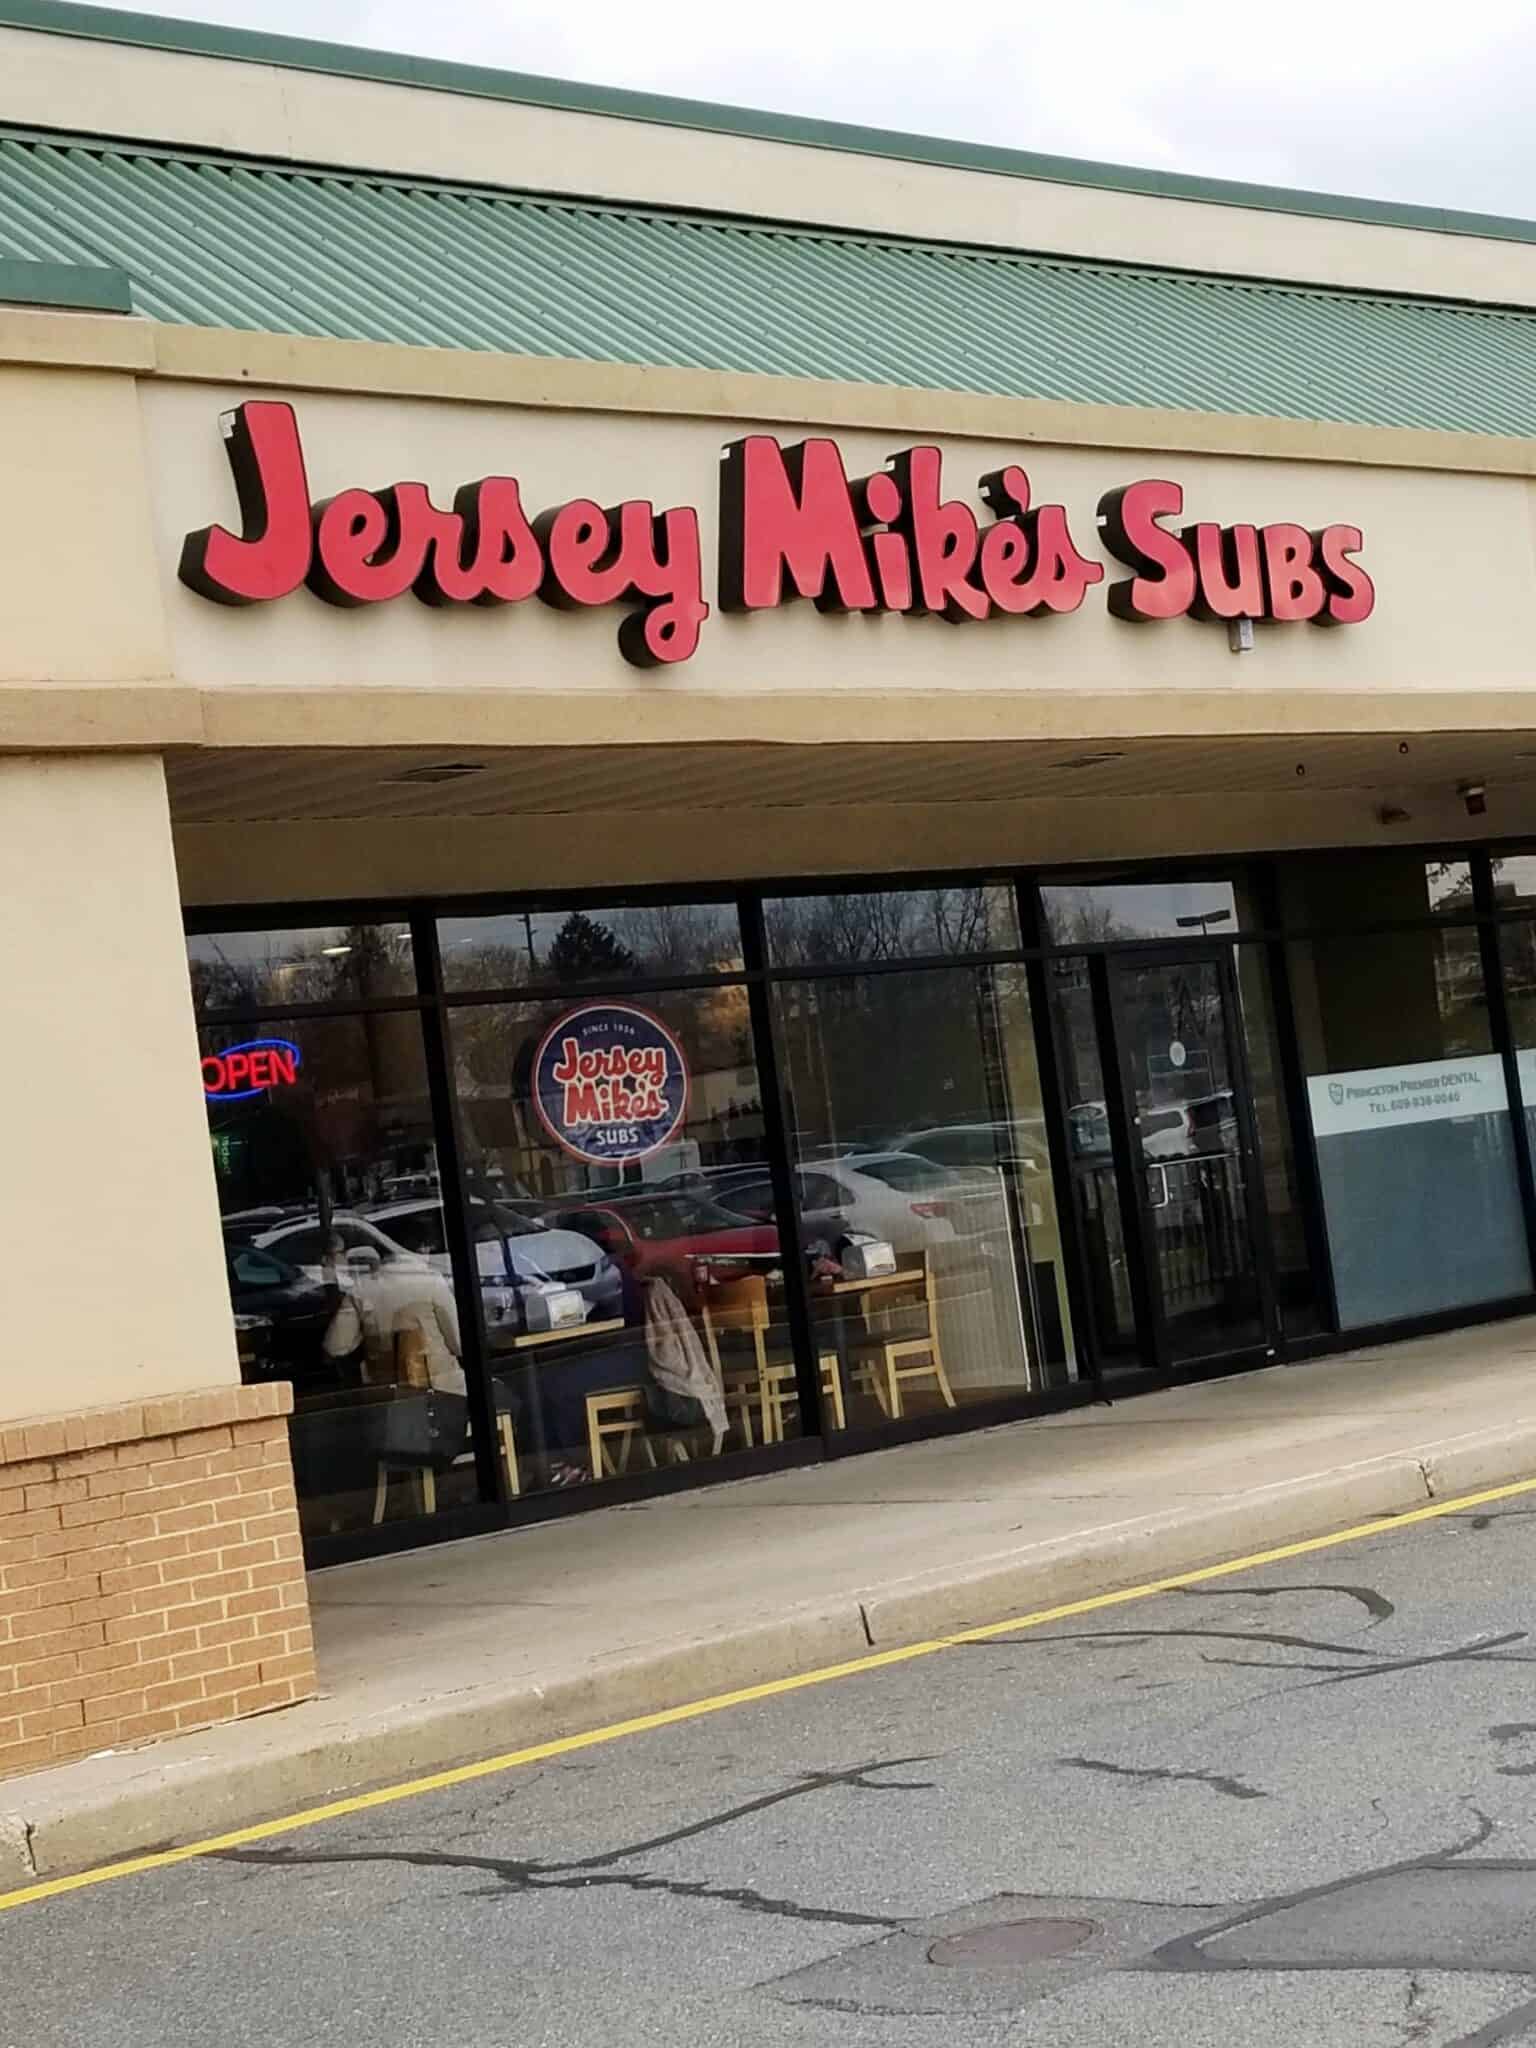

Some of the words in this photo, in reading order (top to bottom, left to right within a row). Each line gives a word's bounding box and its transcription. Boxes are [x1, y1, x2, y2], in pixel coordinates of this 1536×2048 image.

[180, 400, 709, 665] Jersey
[720, 434, 1104, 623] Mike's
[582, 1023, 609, 1037] SINCE
[201, 1049, 296, 1092] OPEN
[553, 1037, 668, 1088] Jersey
[1441, 1071, 1481, 1087] DENTAL
[564, 1078, 669, 1126] Mike's
[596, 1127, 639, 1145] SUBS
